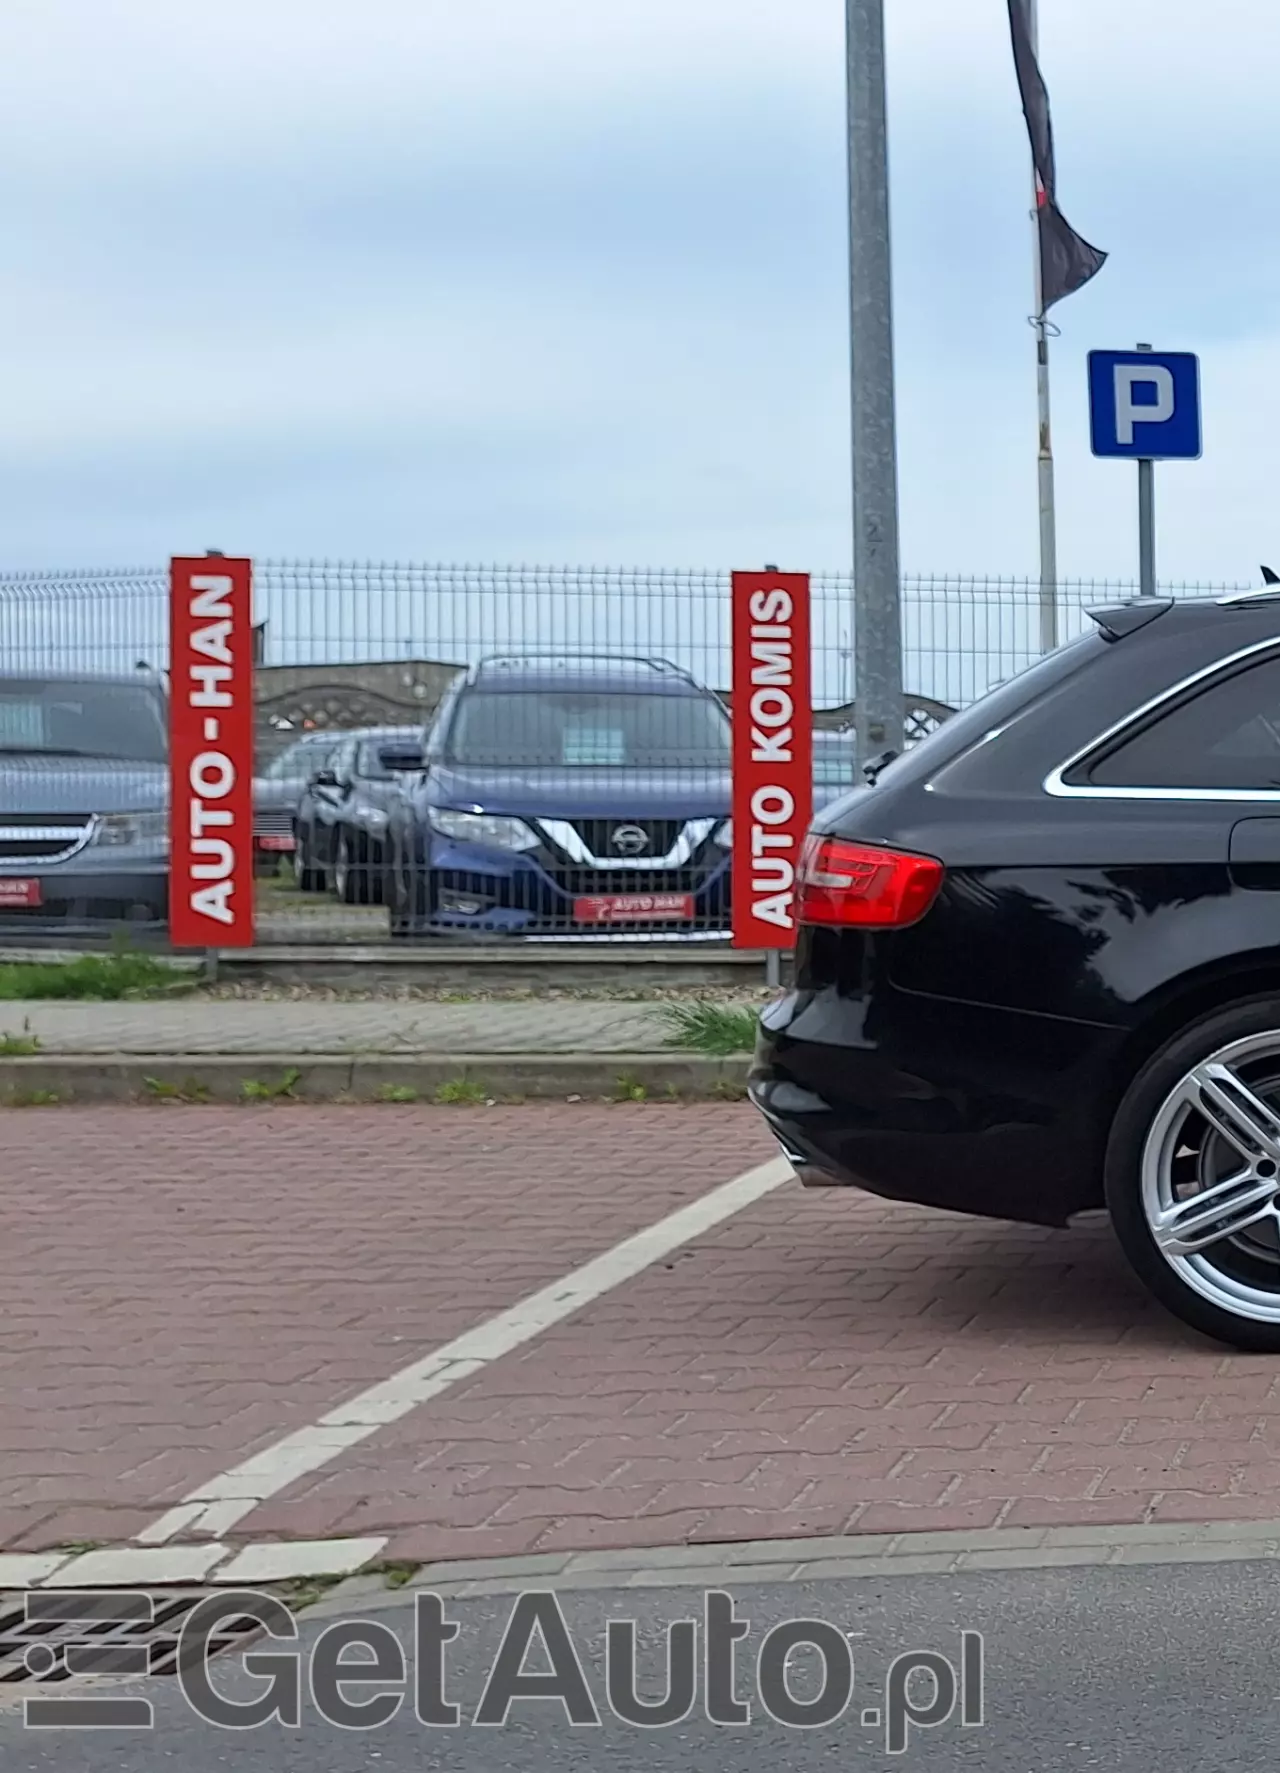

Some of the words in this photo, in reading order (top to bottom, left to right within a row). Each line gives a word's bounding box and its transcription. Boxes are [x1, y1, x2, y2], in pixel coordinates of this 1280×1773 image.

[1113, 365, 1174, 444] P
[749, 588, 794, 762] KOMIS
[750, 784, 795, 929] AUTO
